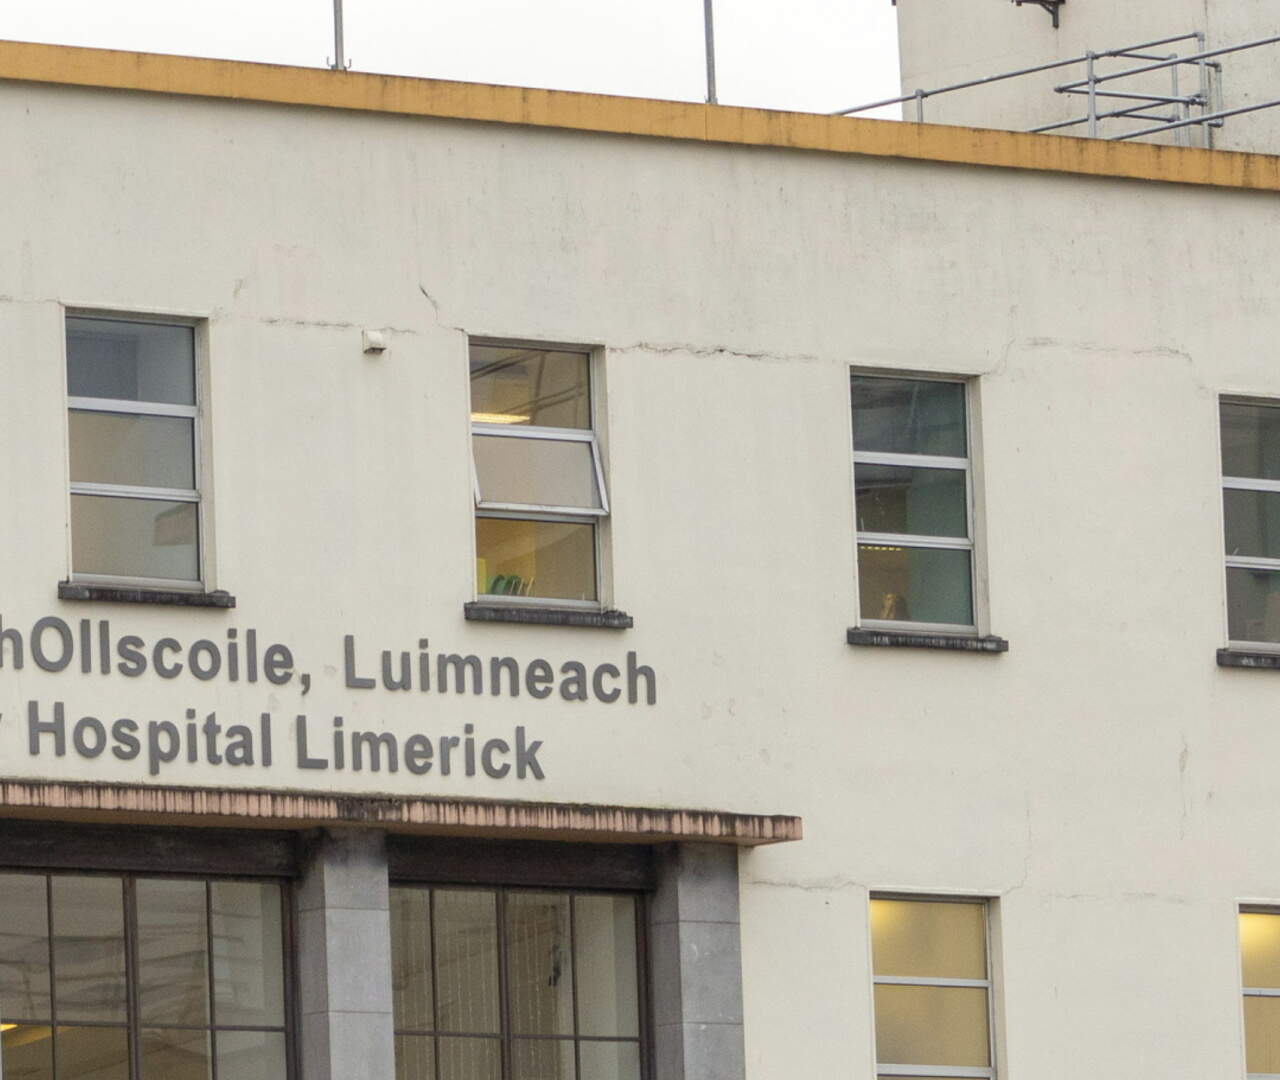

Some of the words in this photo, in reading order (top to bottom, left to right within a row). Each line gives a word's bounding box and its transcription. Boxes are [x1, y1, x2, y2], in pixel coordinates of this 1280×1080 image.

[345, 634, 657, 705] Luimneach
[28, 700, 271, 776] Hospital
[296, 714, 546, 780] Limerick
